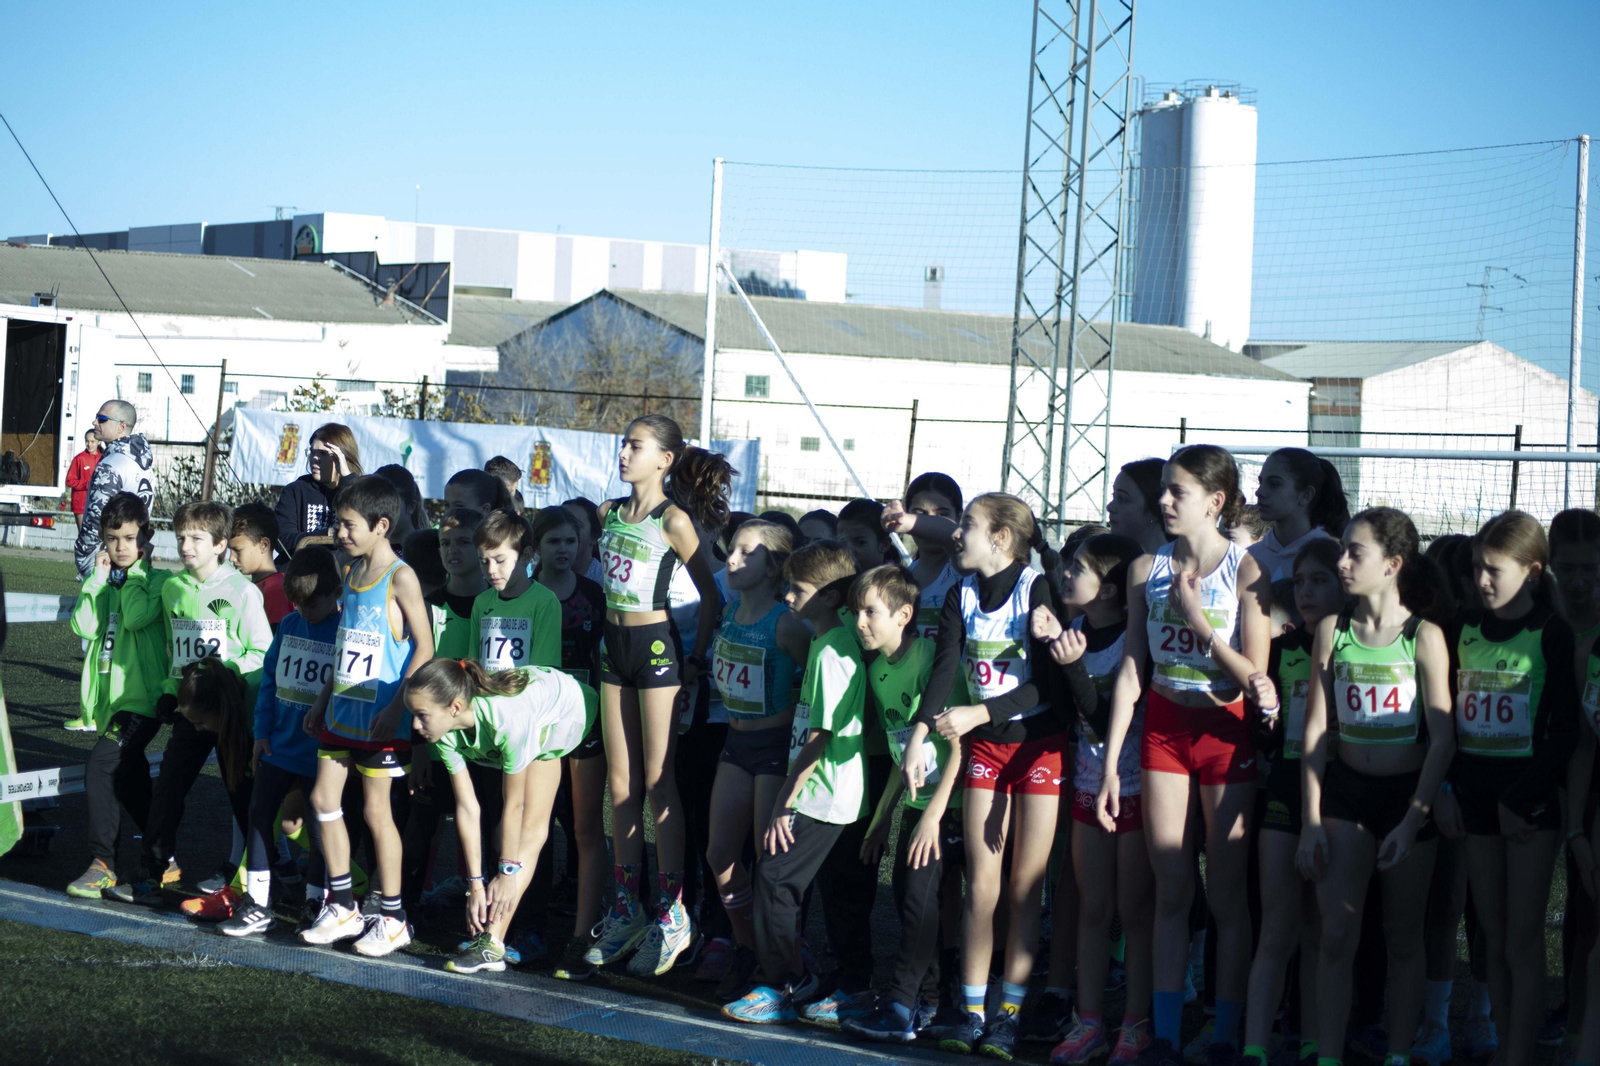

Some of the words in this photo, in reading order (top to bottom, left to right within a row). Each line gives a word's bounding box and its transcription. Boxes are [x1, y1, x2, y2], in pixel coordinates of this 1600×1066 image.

[603, 551, 632, 583] 623
[176, 636, 221, 658] 1162
[283, 655, 334, 685] 1180
[716, 658, 750, 689] 274
[966, 658, 1010, 686] 297
[1346, 684, 1402, 714] 614
[1464, 693, 1514, 724] 616
[8, 782, 34, 795] DEPORTES
